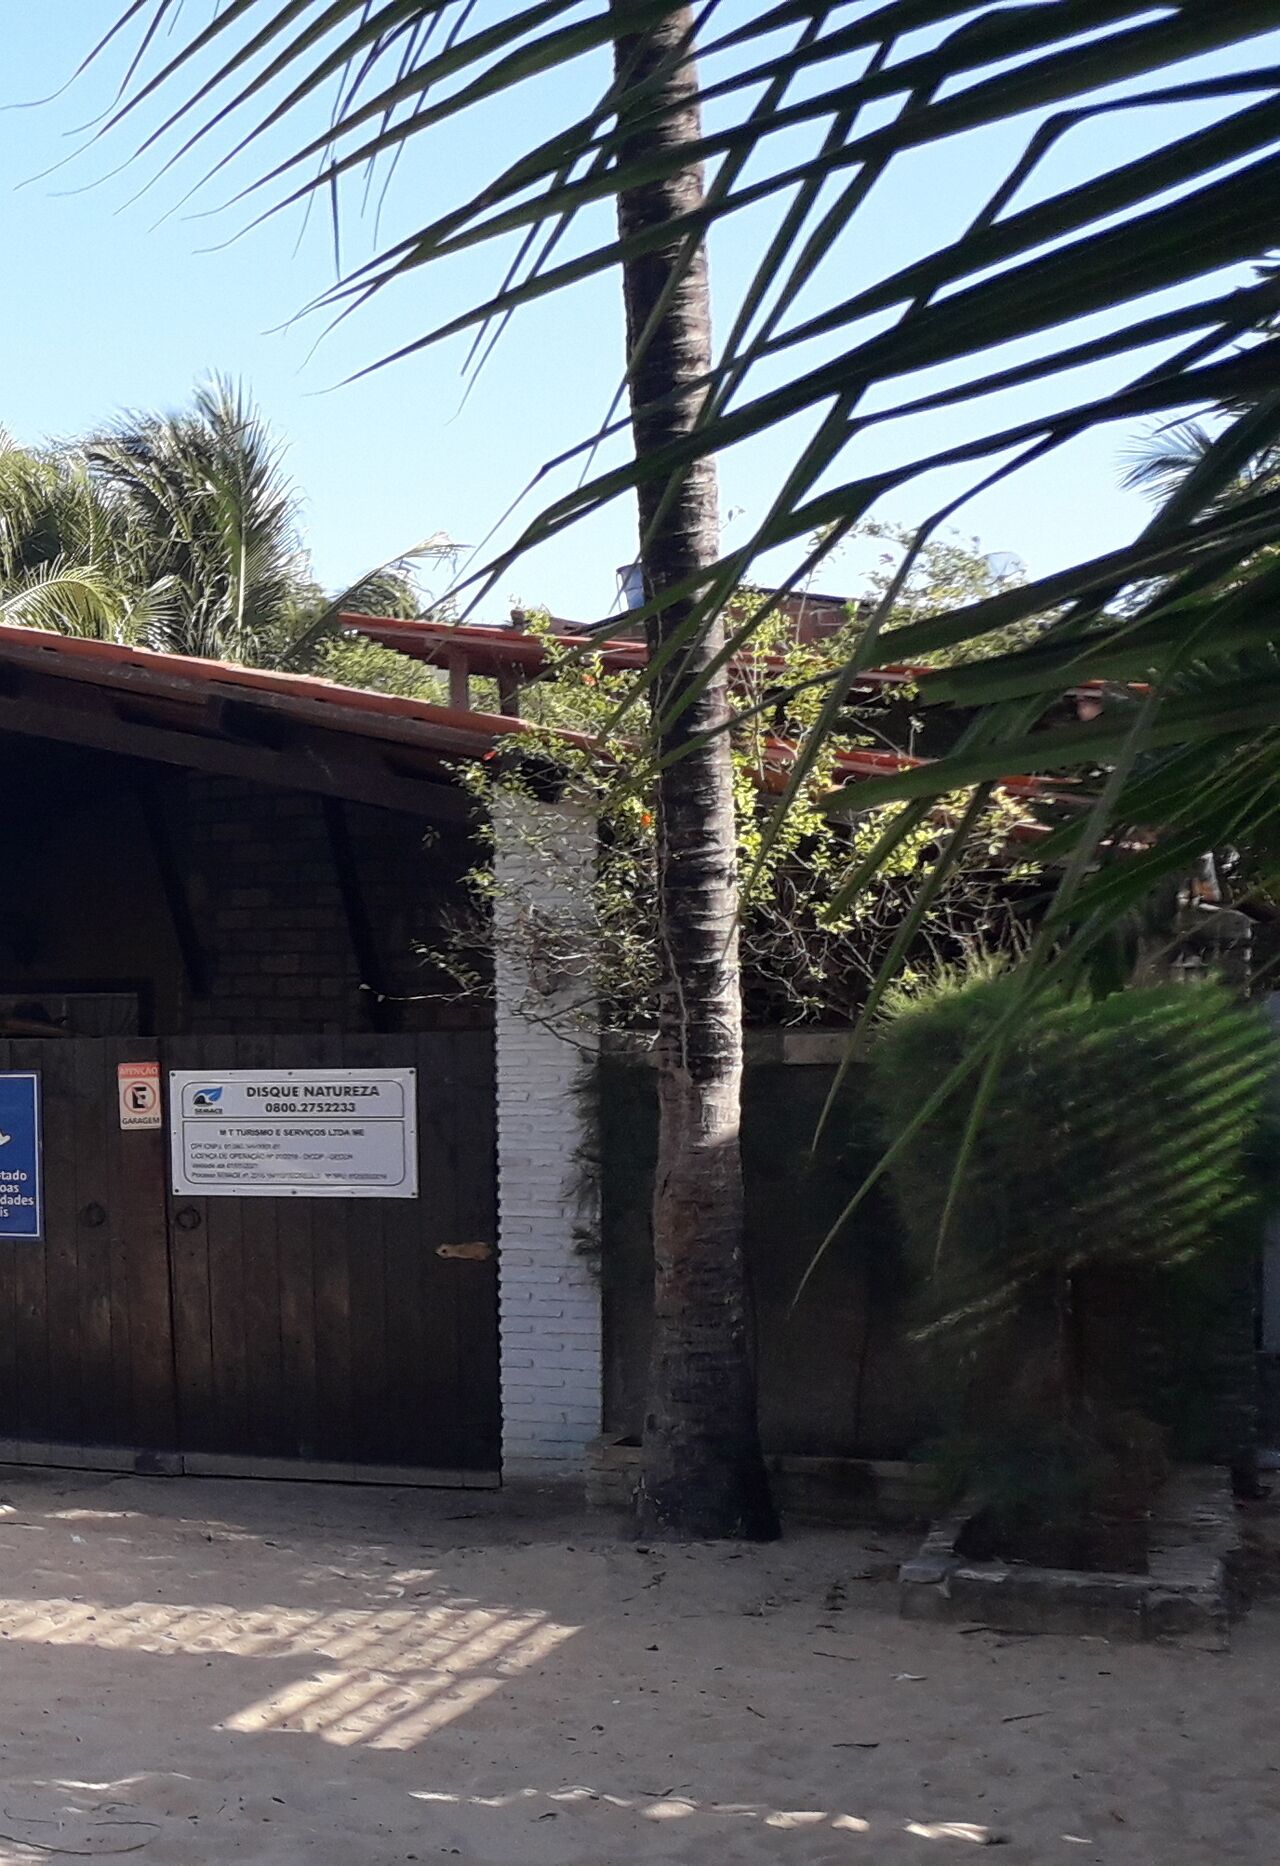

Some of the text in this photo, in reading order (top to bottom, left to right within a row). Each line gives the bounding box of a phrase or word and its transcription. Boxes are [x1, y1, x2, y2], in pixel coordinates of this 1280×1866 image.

[246, 1085, 380, 1098] DISQUE NATUREZA
[265, 1102, 356, 1113] 0800.2752233
[122, 1117, 160, 1125] GARAGEM
[283, 1129, 327, 1137] SERVIÇOS
